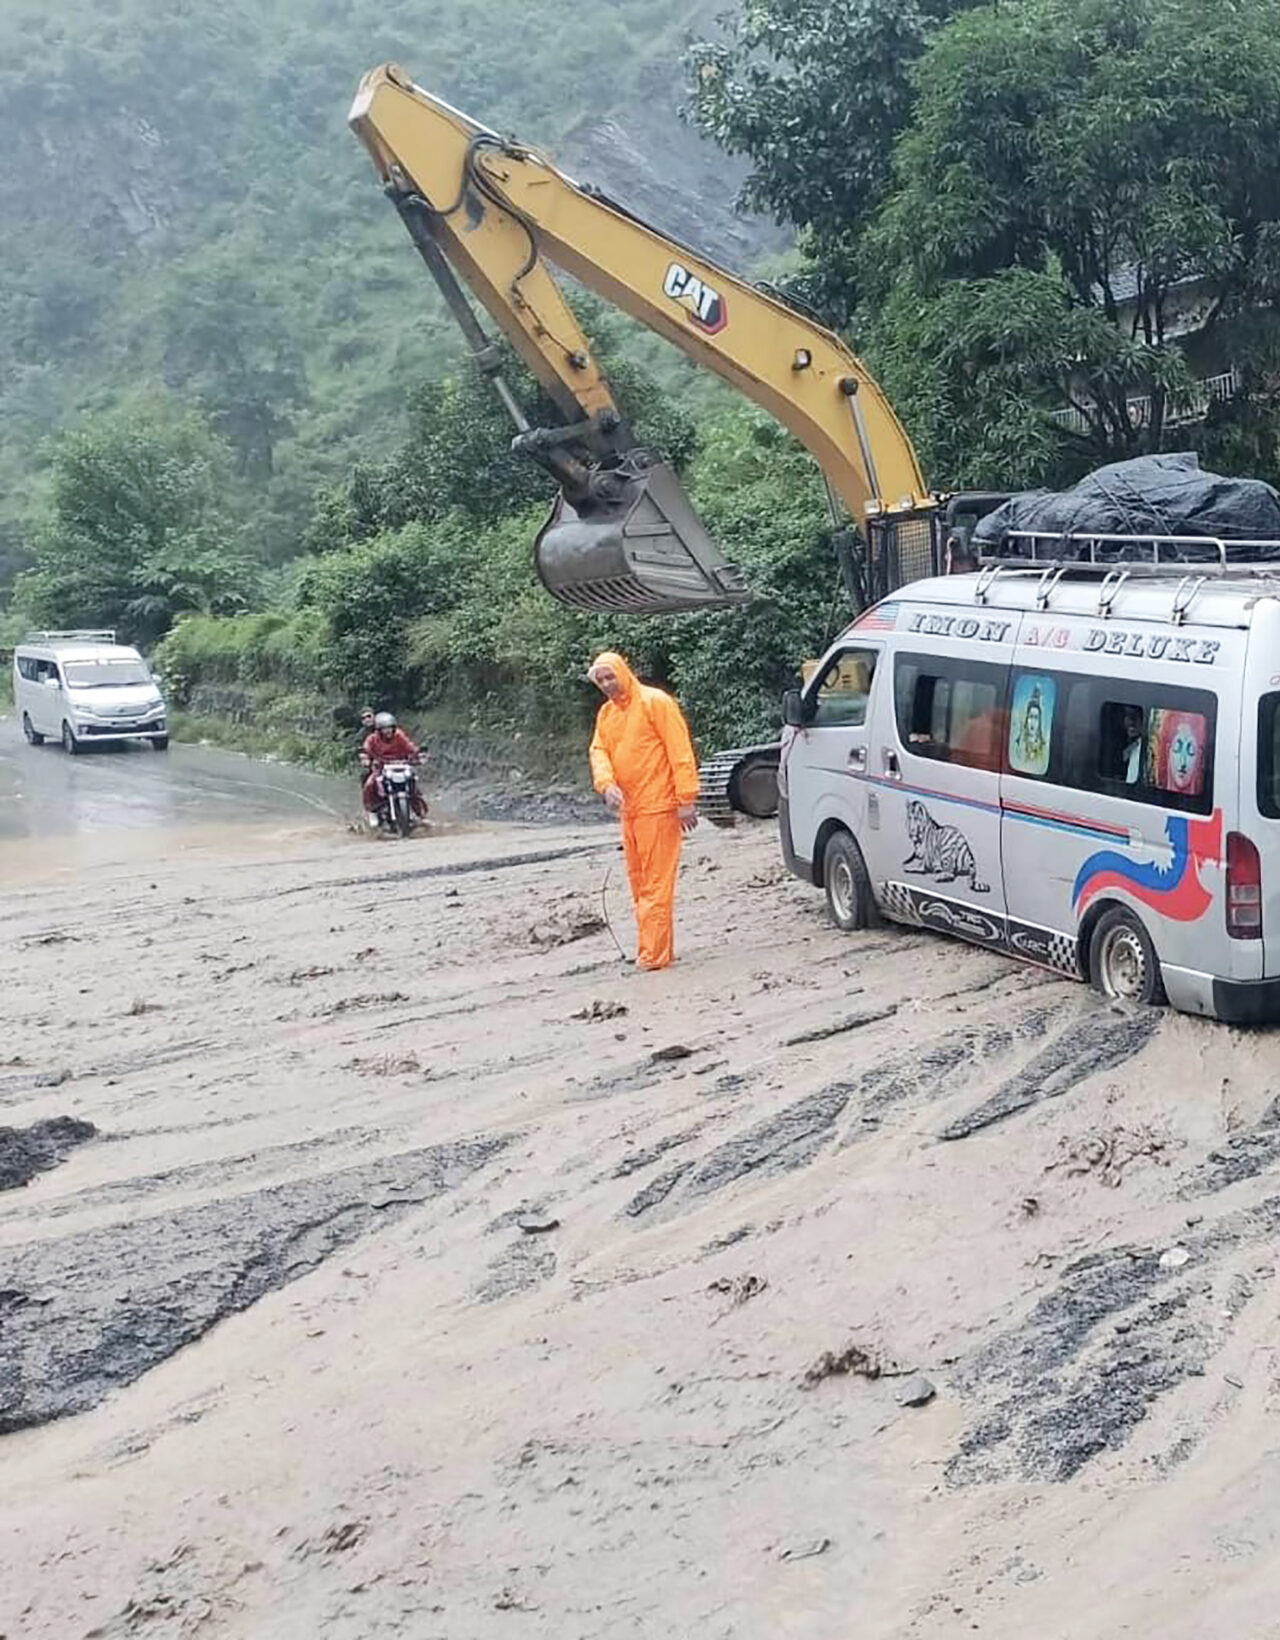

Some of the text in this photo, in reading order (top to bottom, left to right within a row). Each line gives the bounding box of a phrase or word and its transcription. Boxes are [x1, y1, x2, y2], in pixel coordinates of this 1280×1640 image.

[664, 263, 719, 321] CAT
[908, 613, 1221, 664] IMON A/C DELUXE
